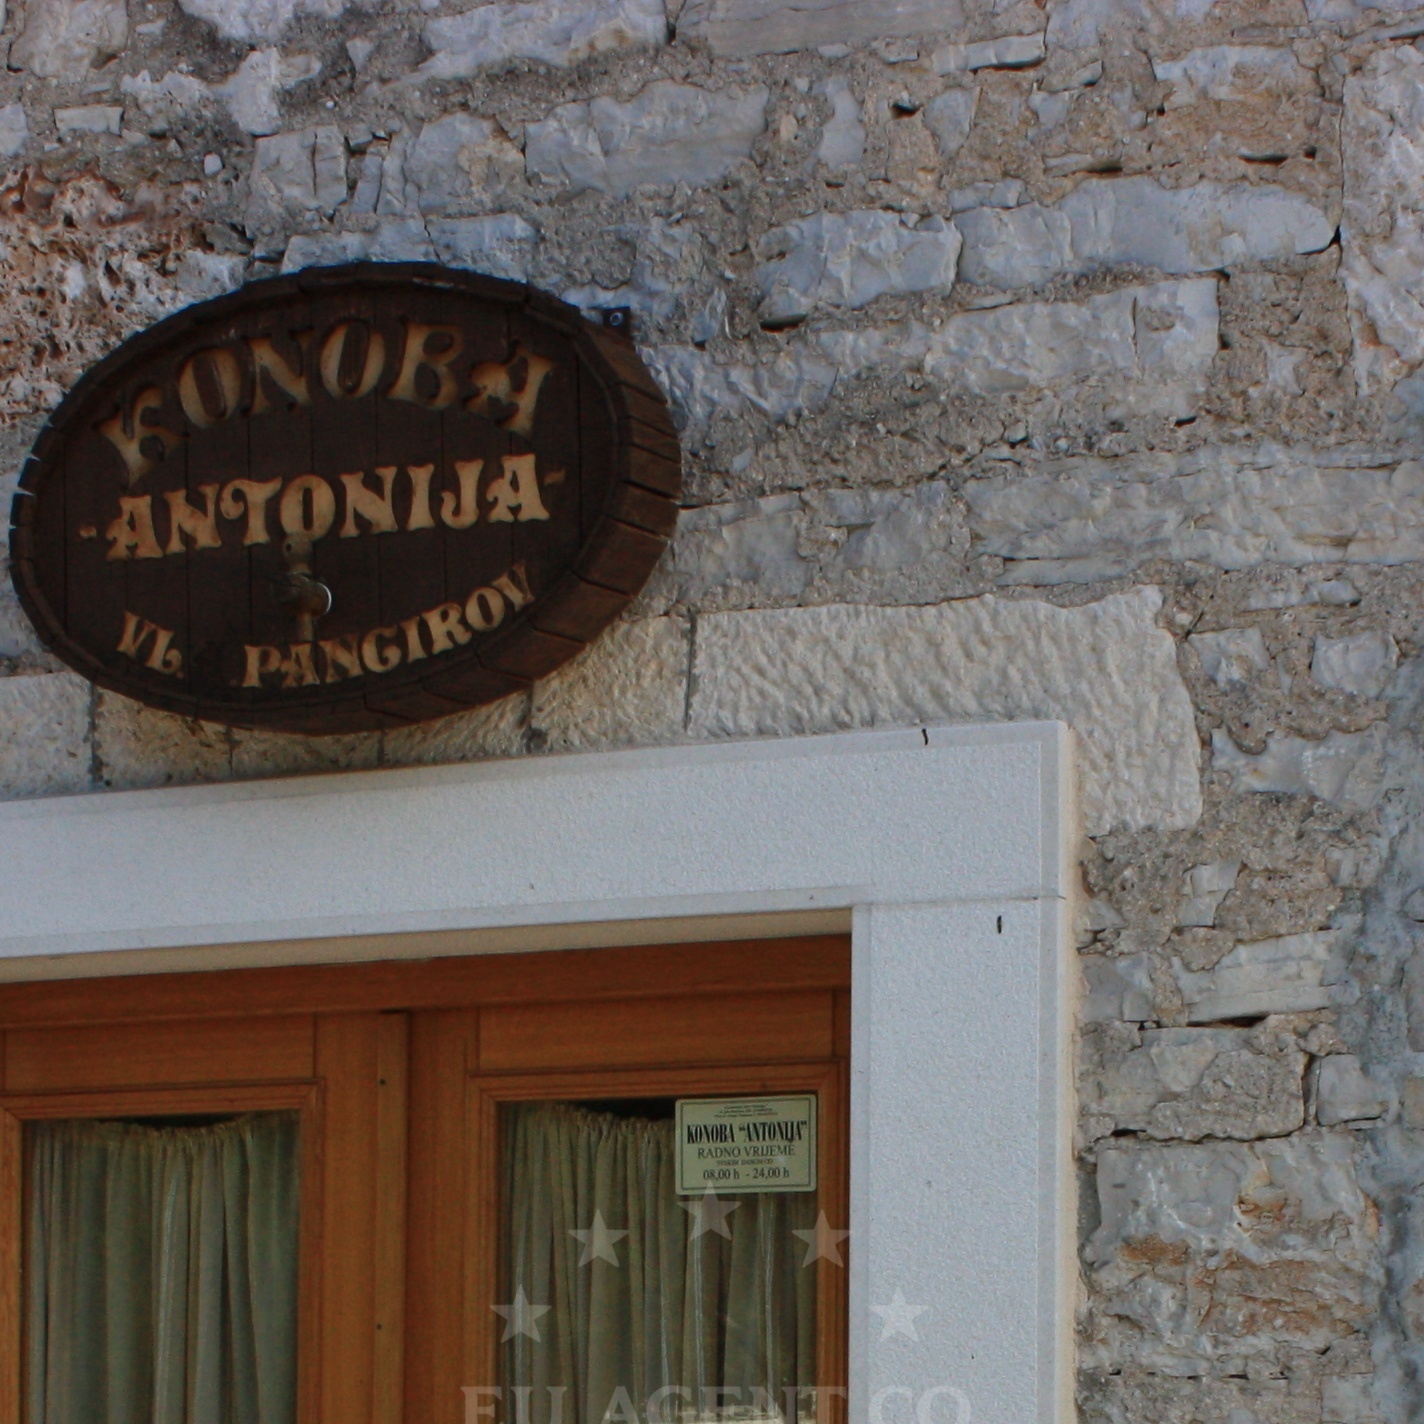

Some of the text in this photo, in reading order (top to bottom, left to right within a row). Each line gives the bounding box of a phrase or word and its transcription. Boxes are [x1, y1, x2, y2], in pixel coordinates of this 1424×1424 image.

[99, 321, 556, 482] KONOBA
[240, 562, 535, 689] PANGIROV
[687, 1123, 735, 1144] KONOBA
[697, 1144, 796, 1159] RADNO VRIJEME
[703, 1168, 731, 1181] 08,00
[733, 1168, 740, 1180] h
[753, 1167, 781, 1180] 24,00
[783, 1166, 790, 1178] h
